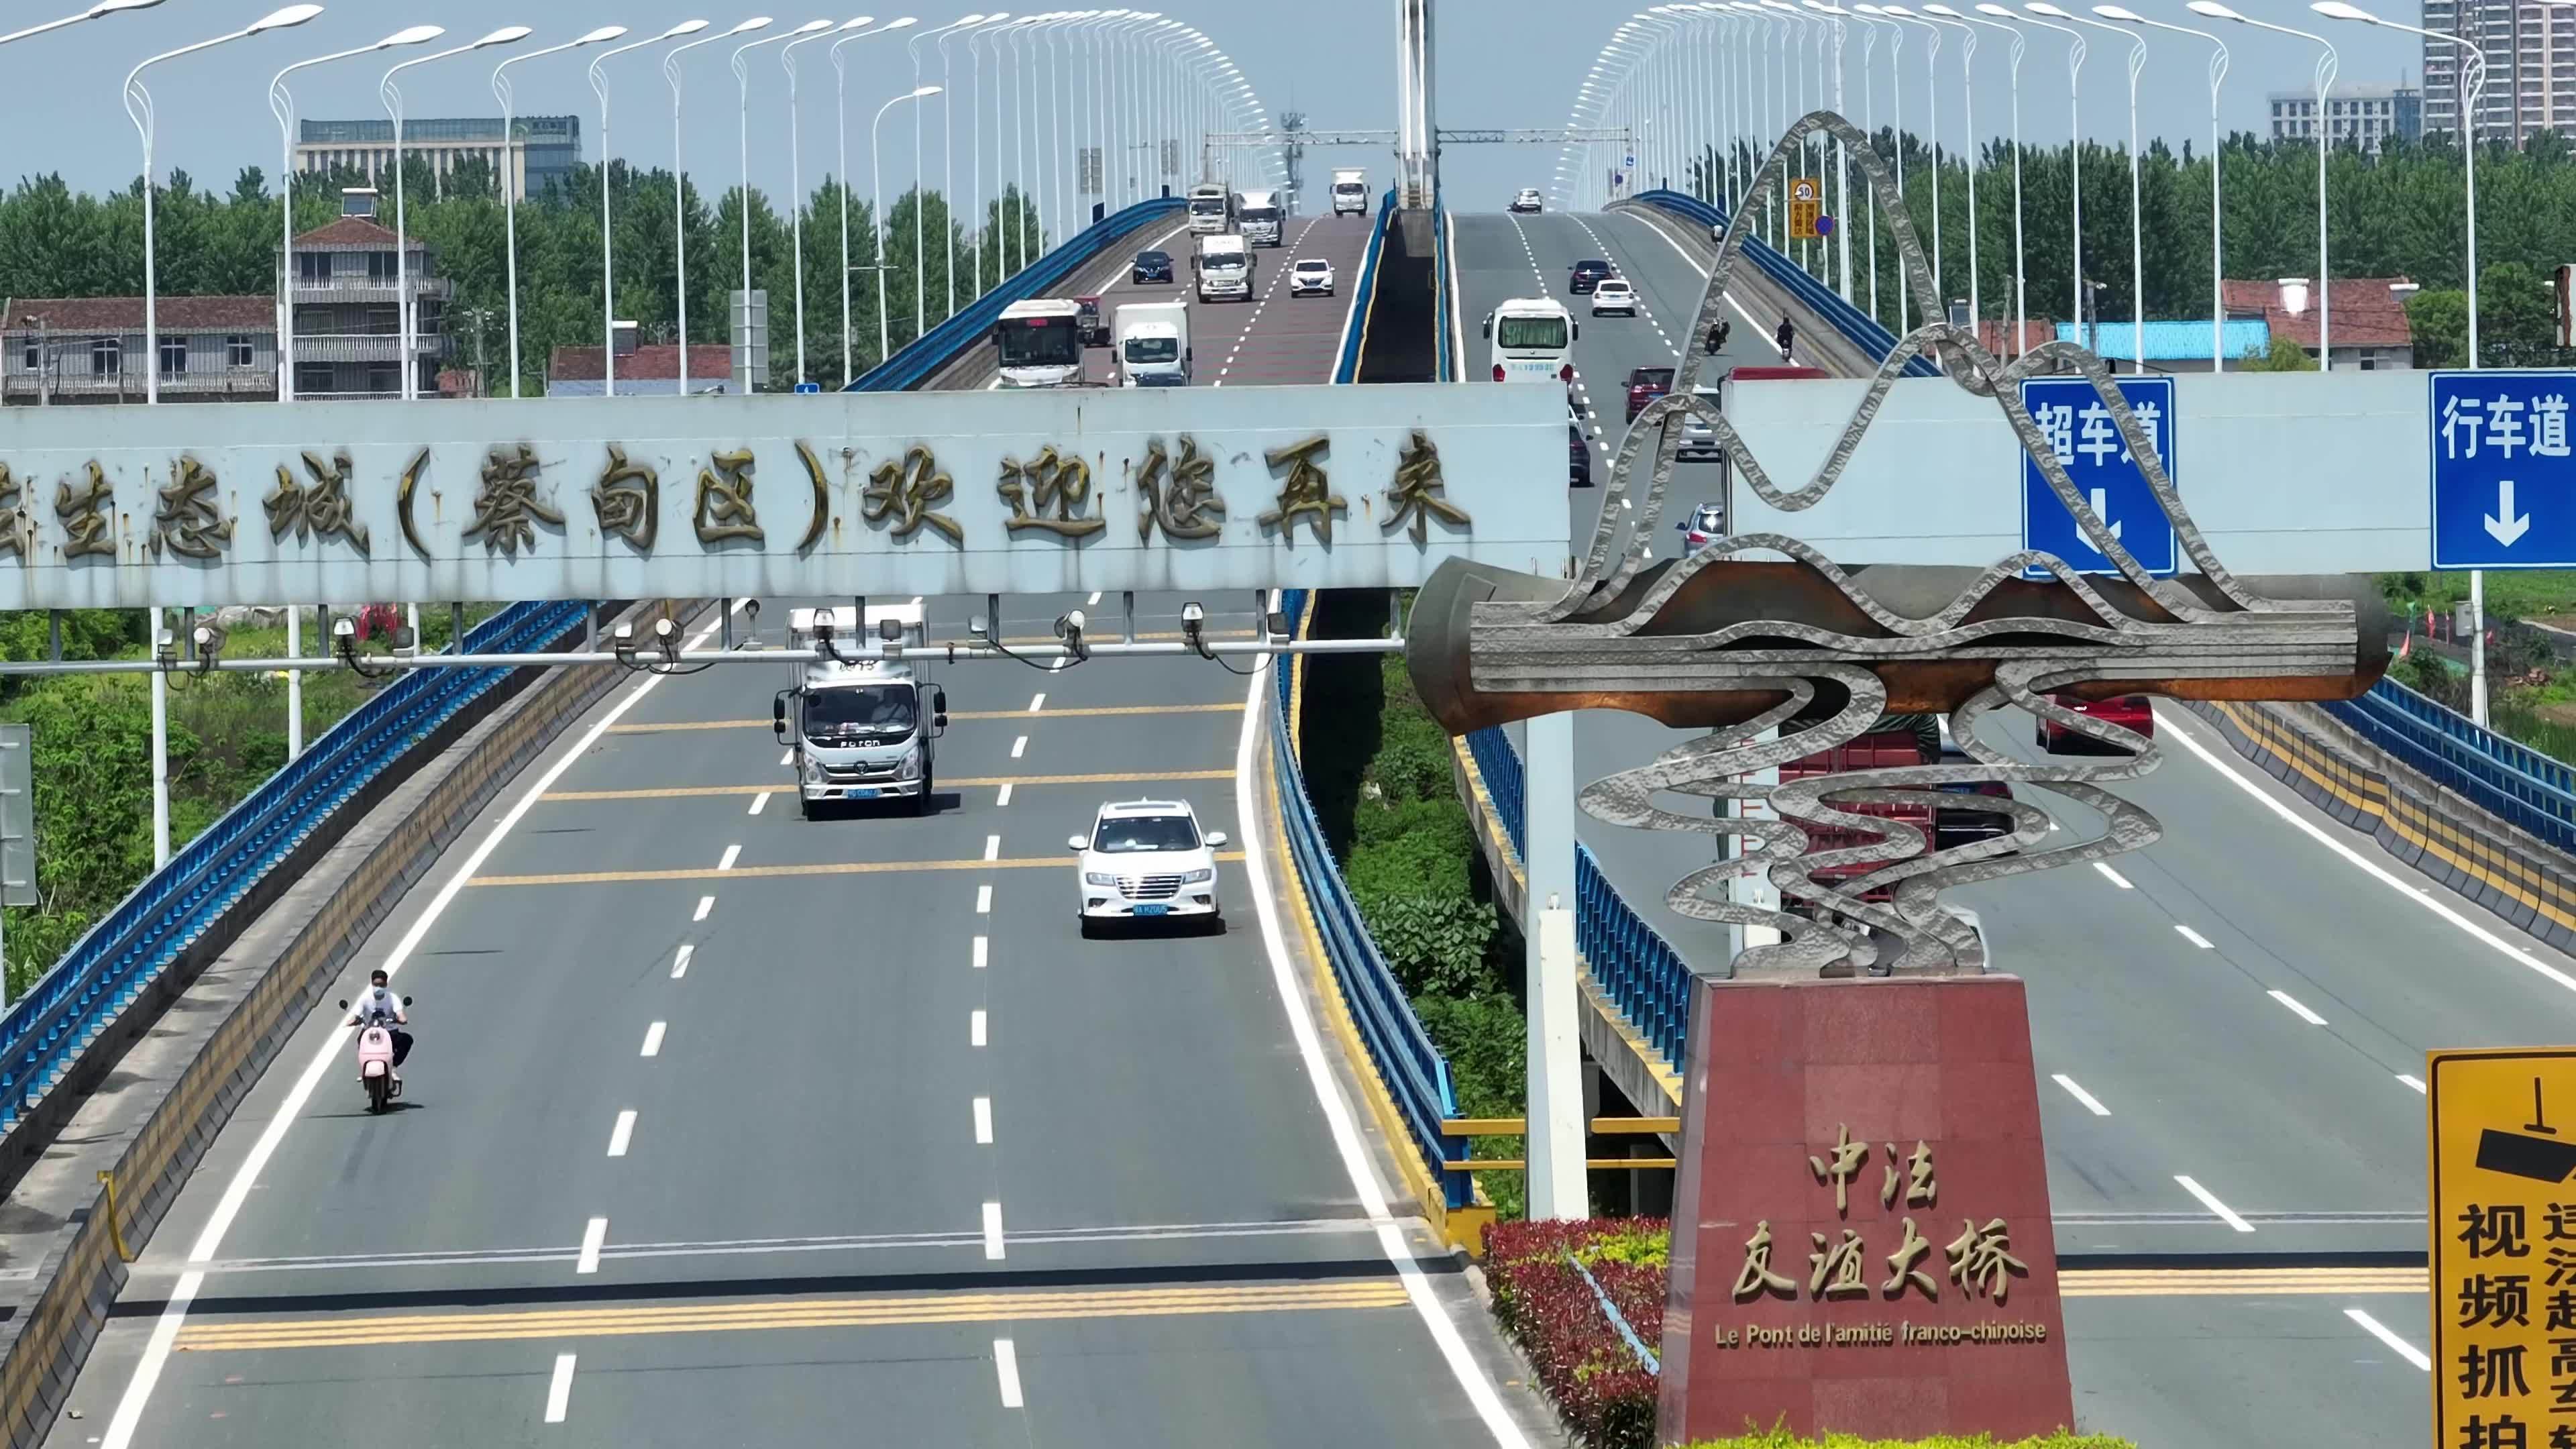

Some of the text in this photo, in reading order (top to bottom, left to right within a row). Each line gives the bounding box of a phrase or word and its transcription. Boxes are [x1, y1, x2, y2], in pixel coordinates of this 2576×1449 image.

[2442, 393, 2571, 459] 行车道
[1810, 1123, 1937, 1211] 中法
[1733, 1217, 2028, 1299] 友谊大桥
[1715, 1324, 1739, 1344] Le
[1747, 1324, 1793, 1344] Pont
[1799, 1323, 1821, 1342] de
[1826, 1320, 1892, 1342] l'amitié
